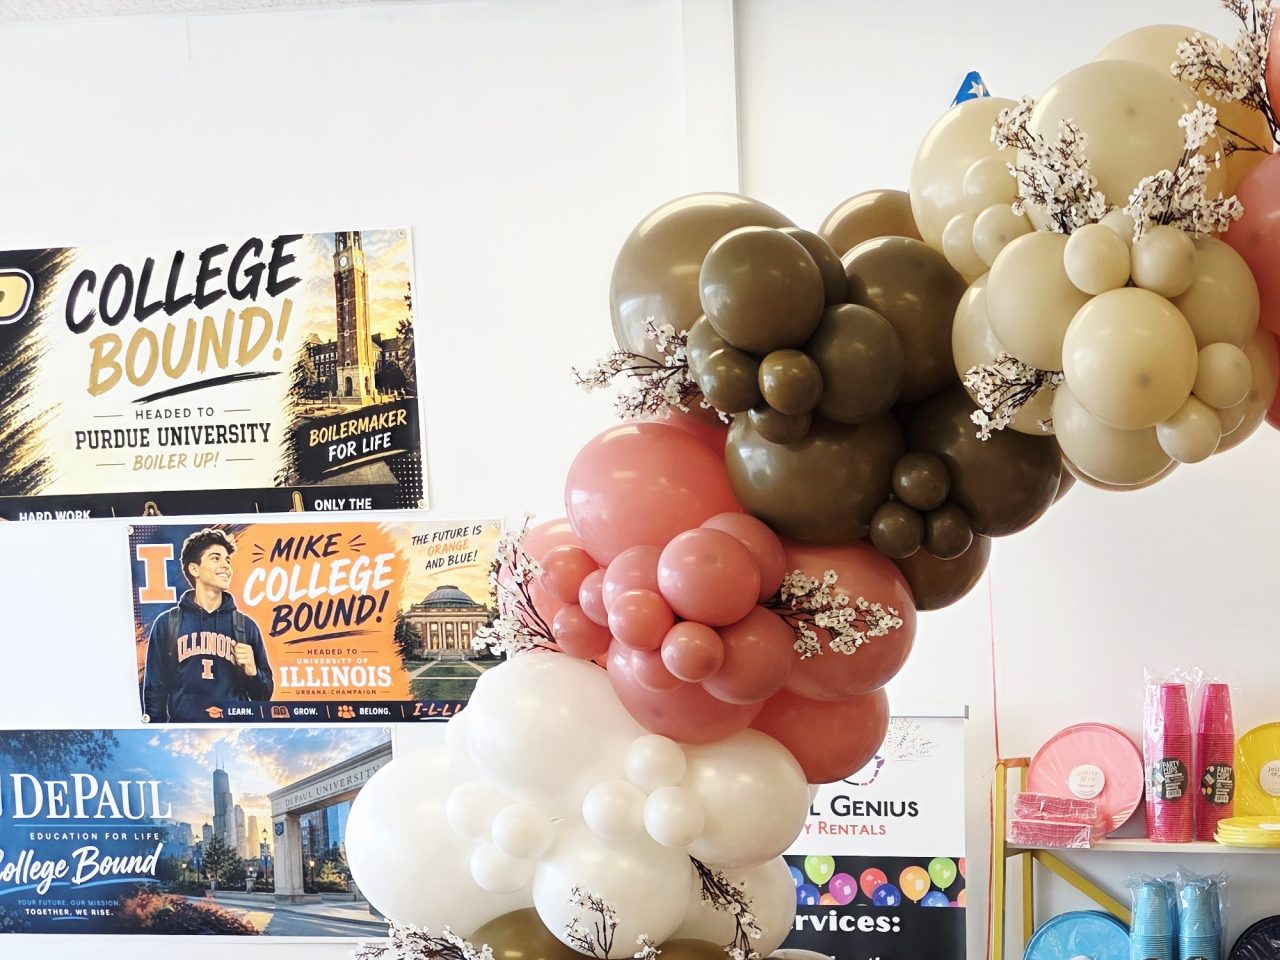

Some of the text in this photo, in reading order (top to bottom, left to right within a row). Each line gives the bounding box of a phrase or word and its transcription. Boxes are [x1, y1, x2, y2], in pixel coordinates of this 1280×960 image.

[65, 233, 304, 334] COLLEGE
[86, 298, 293, 398] BOUND!
[135, 406, 214, 420] HEADED TO
[75, 422, 271, 450] PURDUE UNIVERSITY
[308, 409, 408, 448] BOILERMAKER
[328, 432, 392, 462] FOR LIFE
[132, 452, 220, 471] BOILER UP!
[314, 498, 372, 510] ONLY THE
[19, 510, 91, 521] HARD WORK
[412, 525, 482, 546] THE FUTURE IS
[269, 532, 342, 563] MIKE
[428, 539, 470, 556] ORANGE
[426, 549, 478, 570] AND BLUE!
[243, 553, 396, 607] COLLEGE
[269, 590, 390, 637] BOUND!
[280, 666, 392, 688] ILLINOIS
[228, 706, 254, 716] LEARN.
[294, 707, 318, 716] GROW.
[360, 707, 391, 716] BELONG.
[316, 765, 380, 796] UNIVERSITY
[30, 832, 160, 841] EDUCATION FOR LIFE
[72, 842, 164, 885] Bound
[793, 910, 901, 933] rvices:
